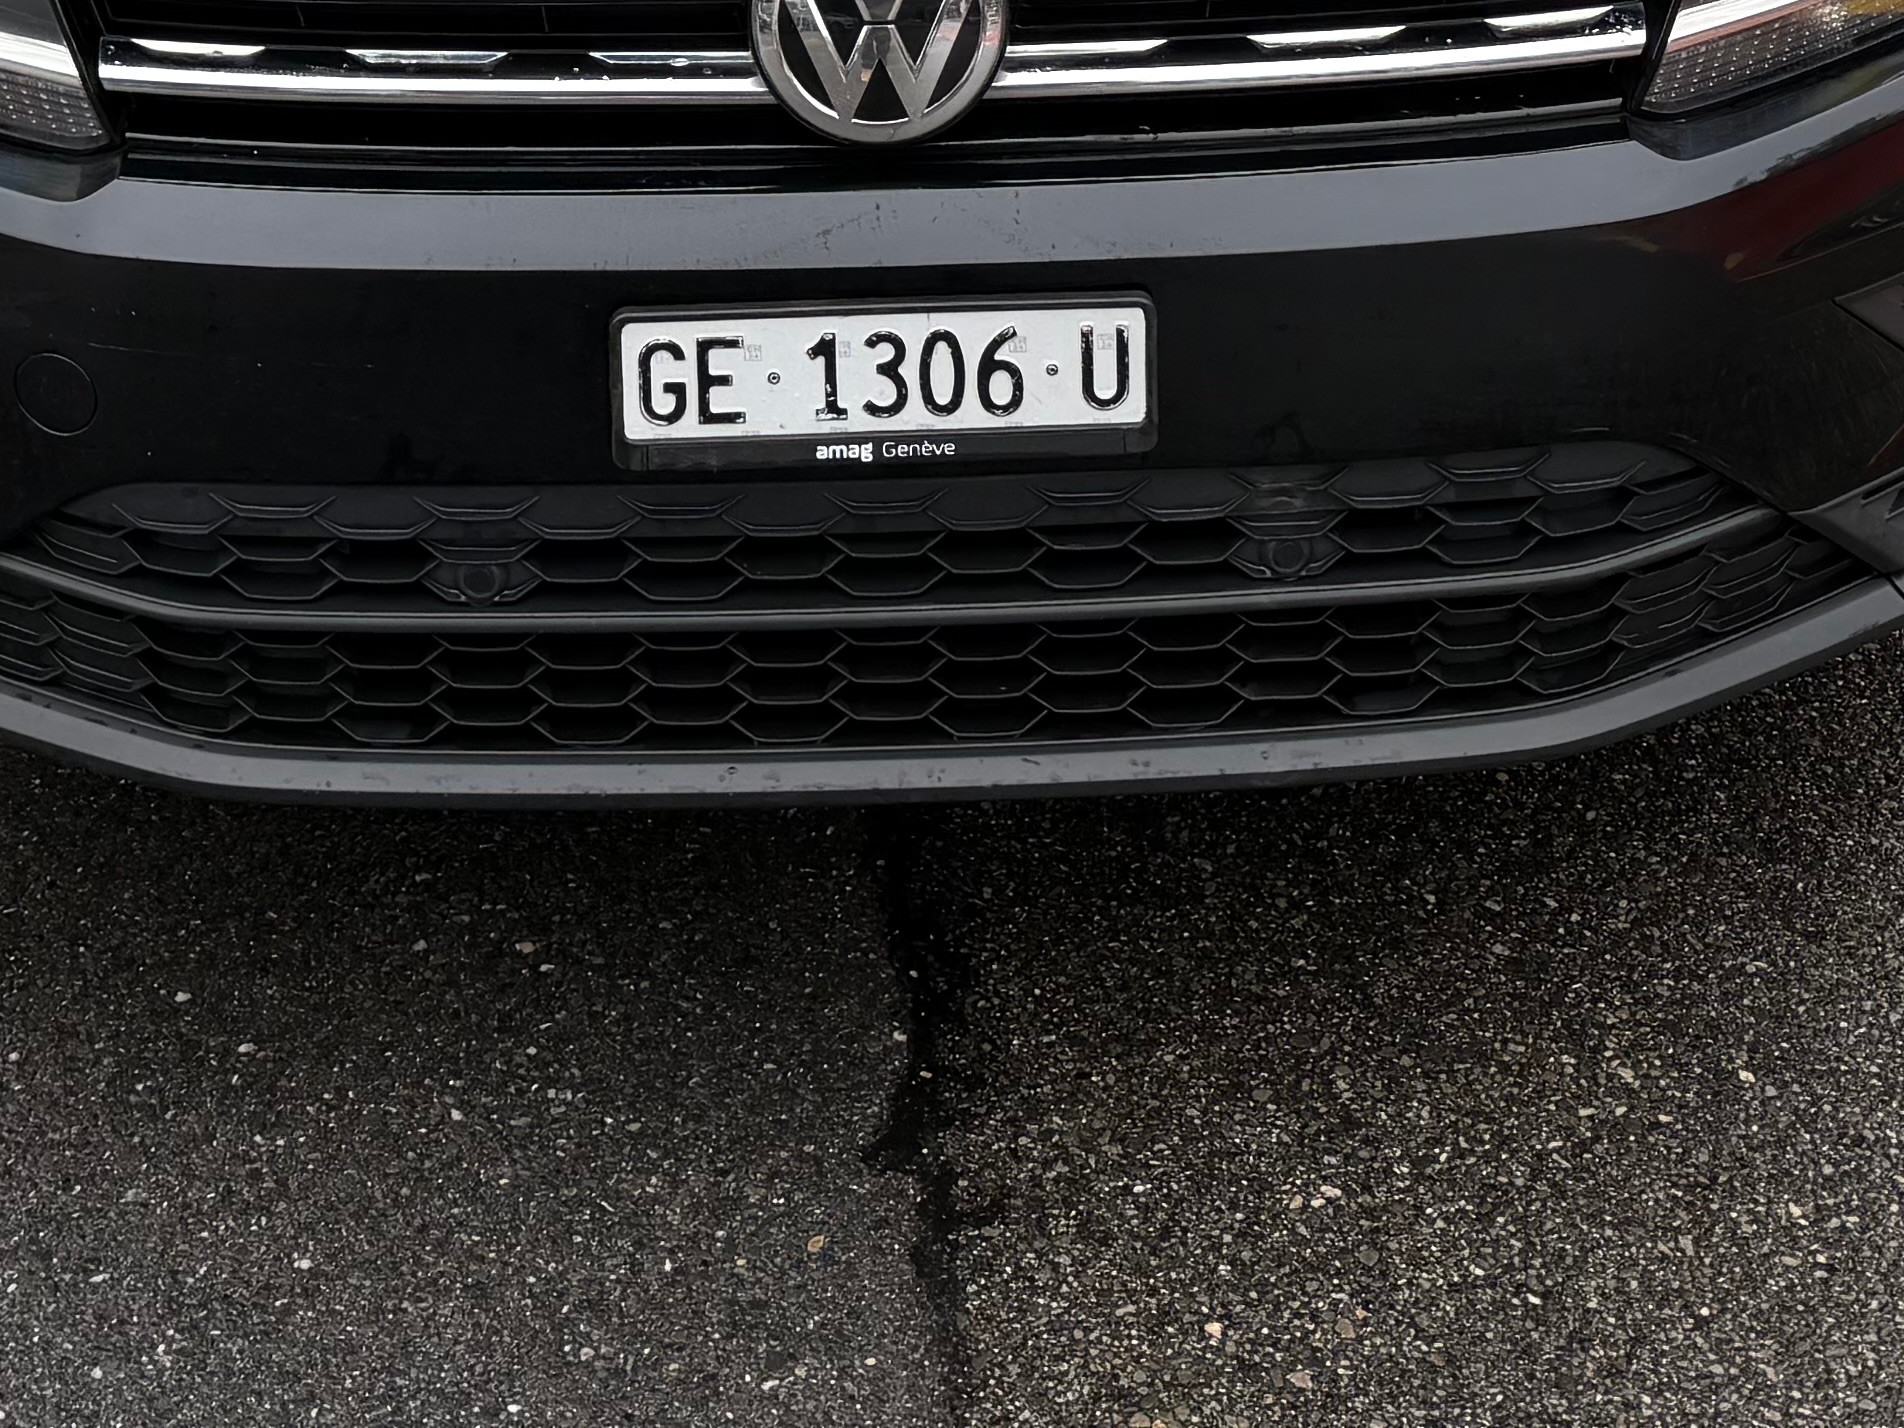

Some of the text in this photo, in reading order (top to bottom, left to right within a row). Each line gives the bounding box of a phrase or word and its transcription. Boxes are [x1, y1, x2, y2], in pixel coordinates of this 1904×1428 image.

[637, 324, 1130, 427] GE 1306 U
[815, 440, 956, 463] amag Genève
